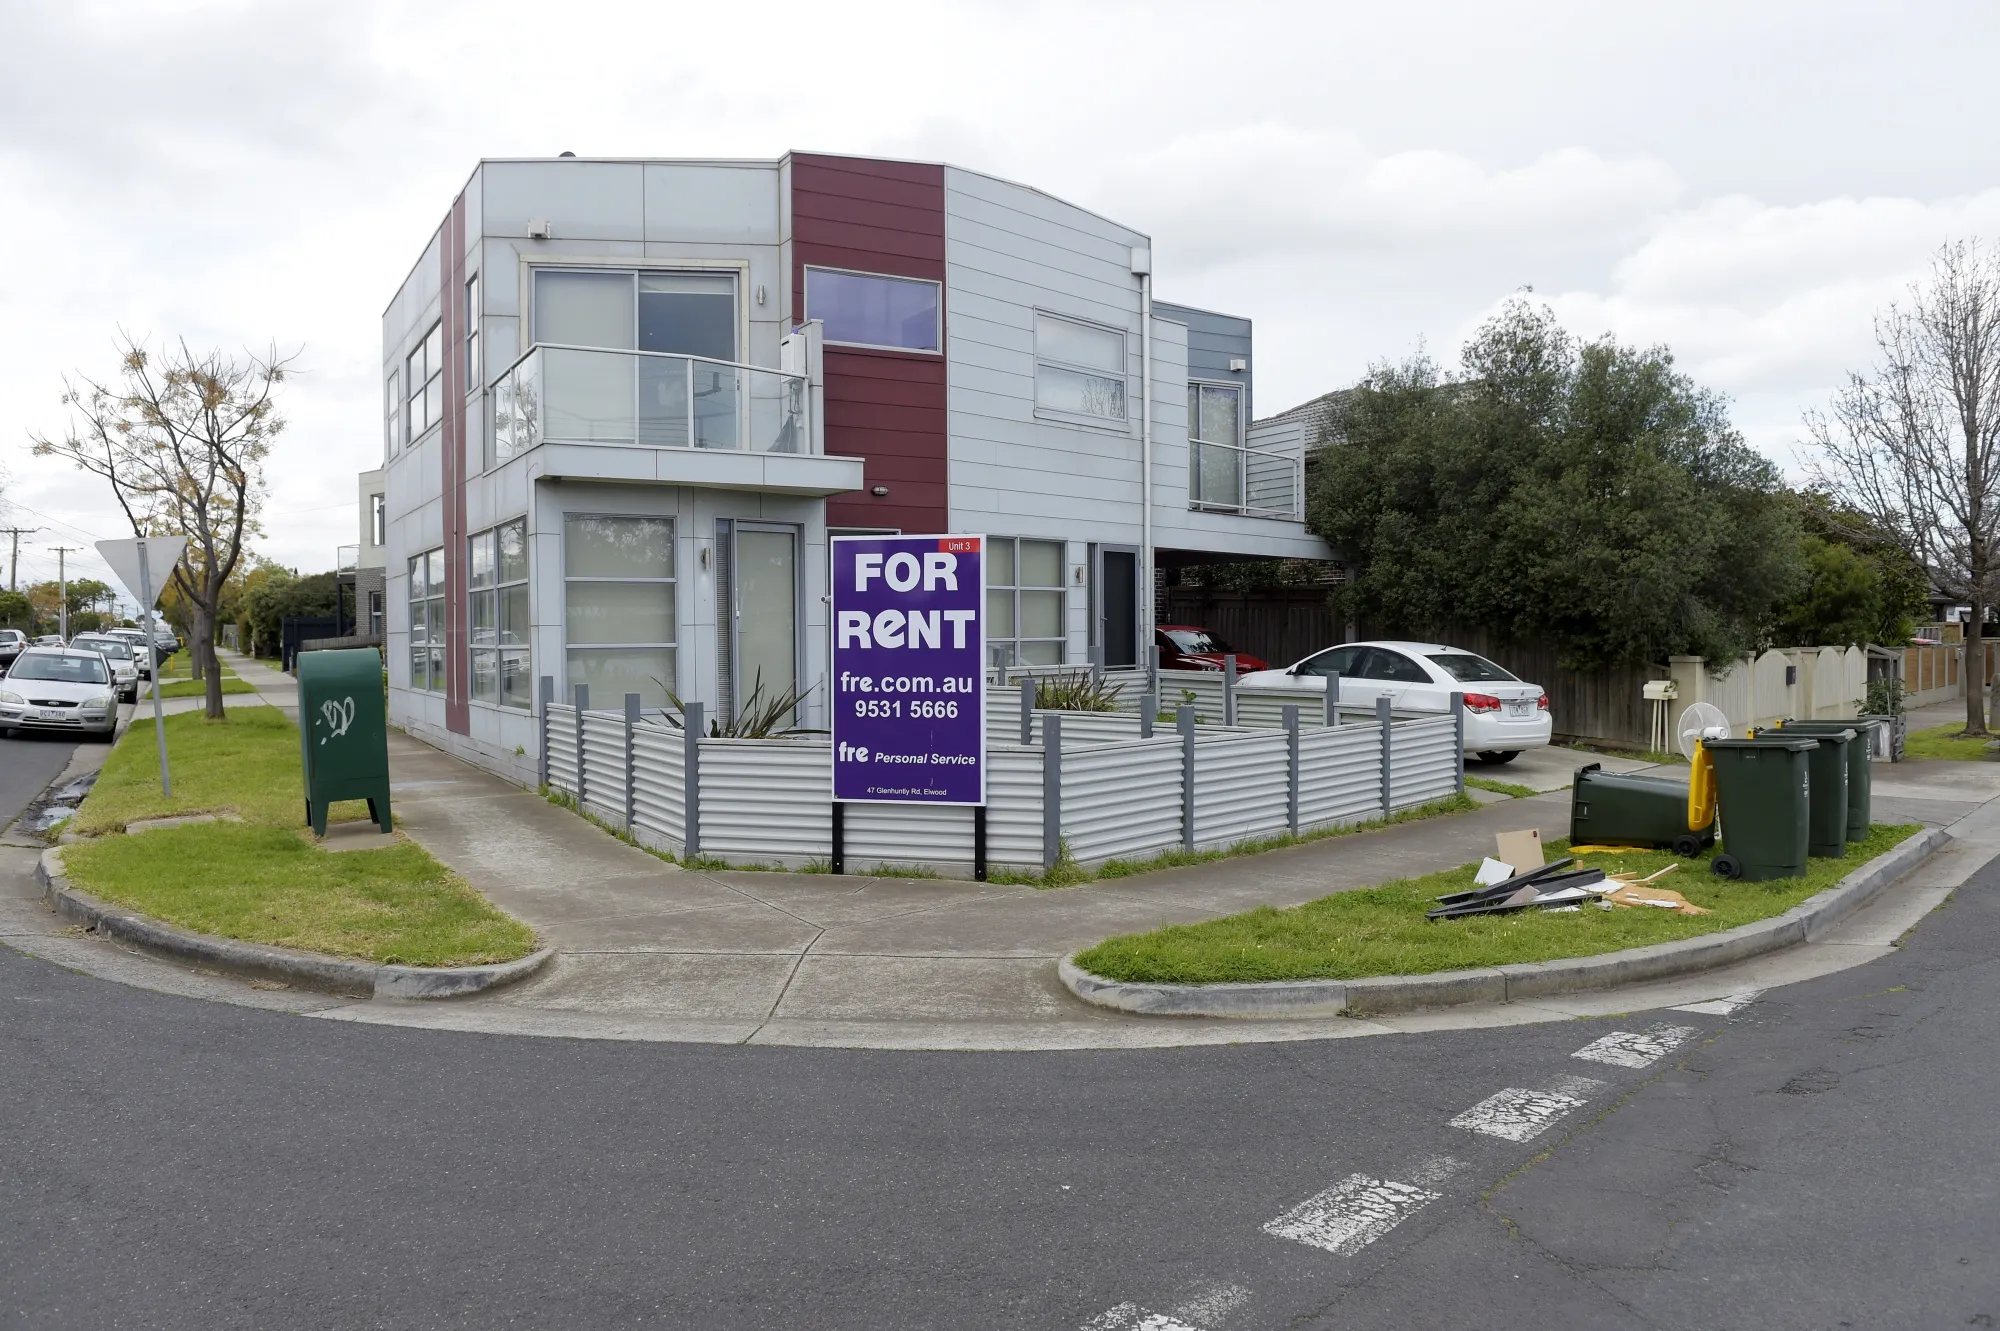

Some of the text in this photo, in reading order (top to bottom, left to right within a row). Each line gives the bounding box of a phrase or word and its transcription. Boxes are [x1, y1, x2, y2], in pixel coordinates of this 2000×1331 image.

[948, 541, 971, 551] Unit 3
[855, 551, 959, 593] FOR
[840, 671, 973, 693] fre.com.au
[855, 700, 959, 719] 9531 5666
[838, 741, 976, 765] fre Personal Service
[876, 787, 910, 796] Glenhuntly
[923, 788, 947, 796] Elwood
